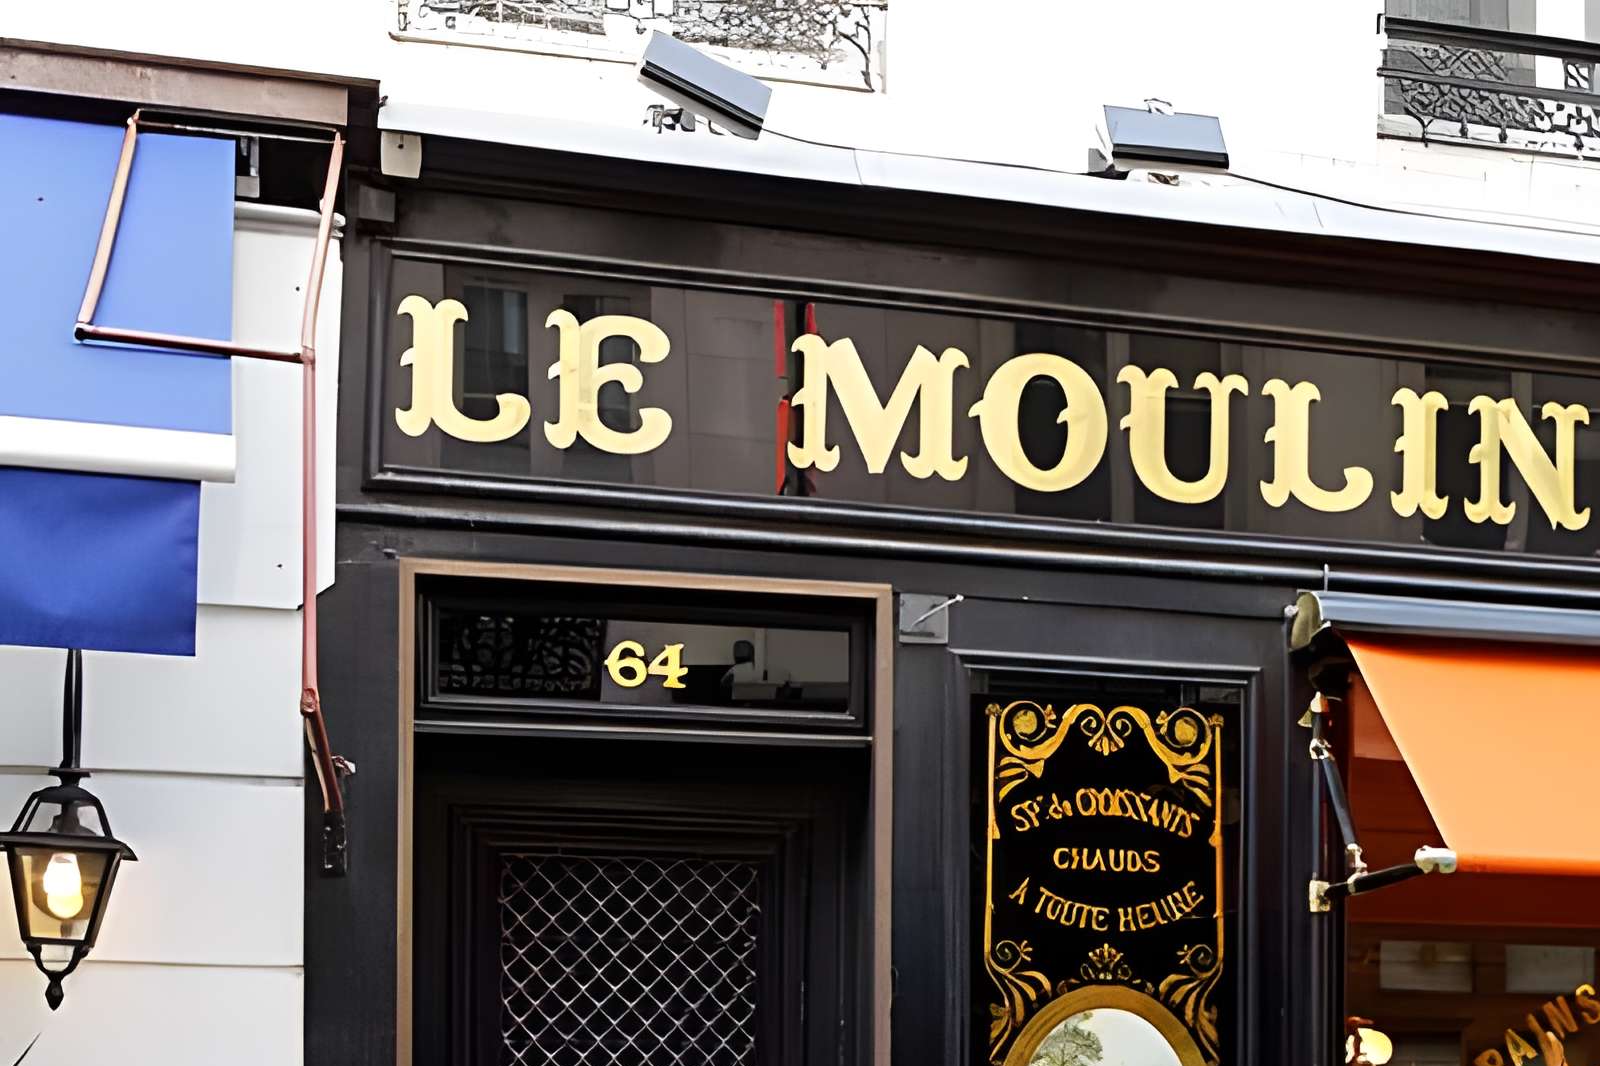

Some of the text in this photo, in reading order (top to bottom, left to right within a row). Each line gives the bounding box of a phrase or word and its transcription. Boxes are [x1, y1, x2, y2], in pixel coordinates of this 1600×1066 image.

[400, 296, 670, 453] LE
[787, 333, 1591, 531] MOULIN
[604, 640, 689, 689] 64
[1053, 847, 1161, 873] CHAUDS
[1035, 886, 1109, 932] TOUTE
